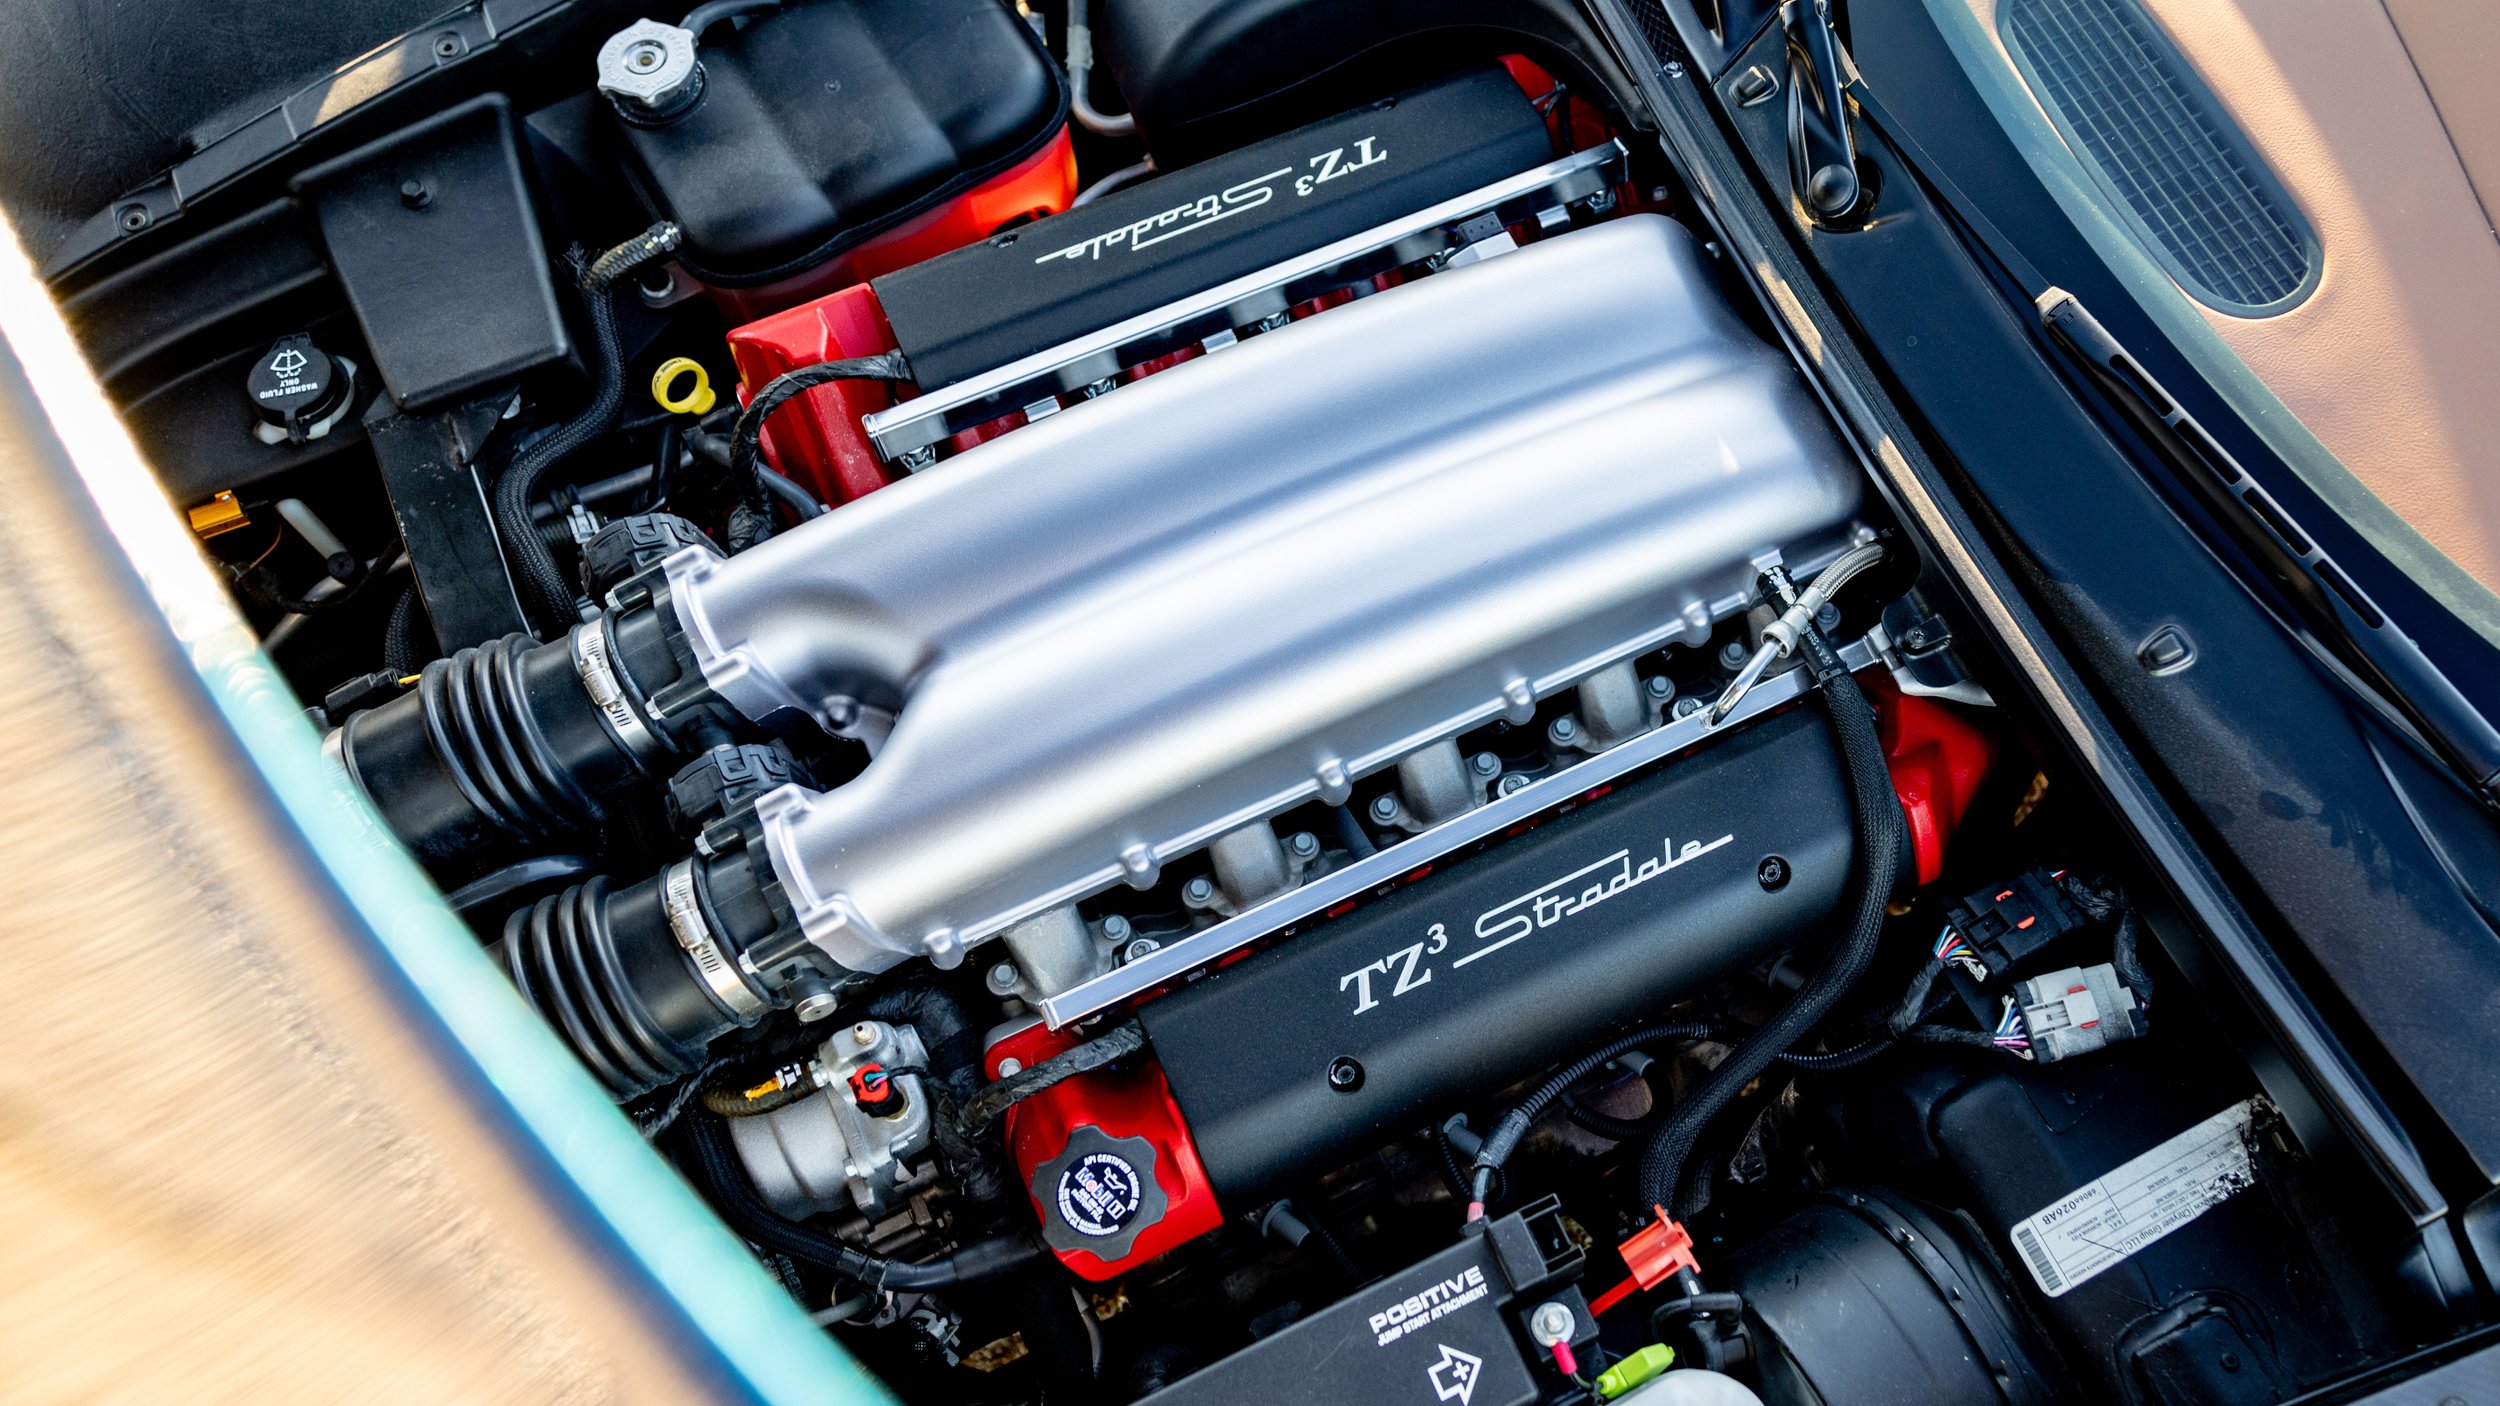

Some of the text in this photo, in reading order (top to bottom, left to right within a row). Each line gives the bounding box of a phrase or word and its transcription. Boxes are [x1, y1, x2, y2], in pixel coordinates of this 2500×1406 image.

[1035, 167, 1292, 265] Stradale
[260, 382, 318, 399] WASHER FLUID
[280, 377, 300, 388] ONLY
[1453, 834, 1734, 969] Stradale
[1084, 1155, 1097, 1166] API
[1097, 1154, 1132, 1174] CERTIFIED
[1074, 1166, 1115, 1208] Mobil
[2041, 1187, 2098, 1225] 68066026AB
[2125, 1207, 2191, 1250] Chrysler Group LLC
[1369, 1265, 1485, 1334] POSITIVE
[1378, 1283, 1489, 1346] JUMP START ATTACHMENT
